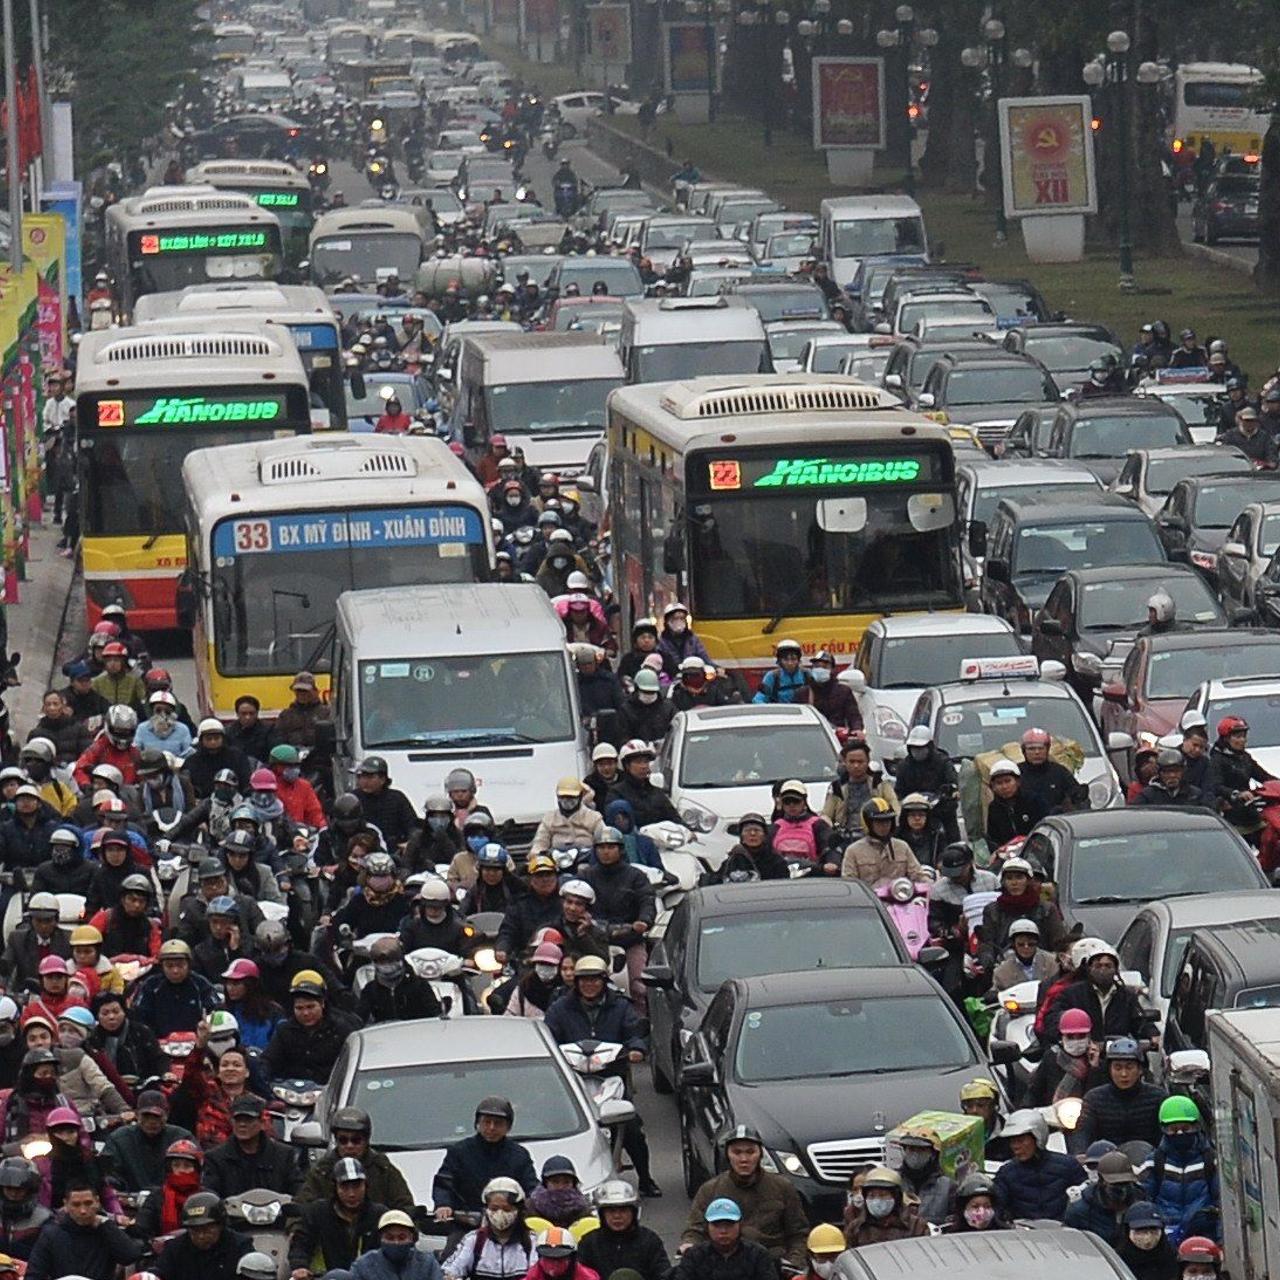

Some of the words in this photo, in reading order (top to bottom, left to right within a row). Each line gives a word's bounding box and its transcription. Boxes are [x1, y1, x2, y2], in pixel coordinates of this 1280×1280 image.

[236, 522, 270, 552] 33
[278, 527, 301, 547] BX
[384, 518, 425, 543] XUÂN
